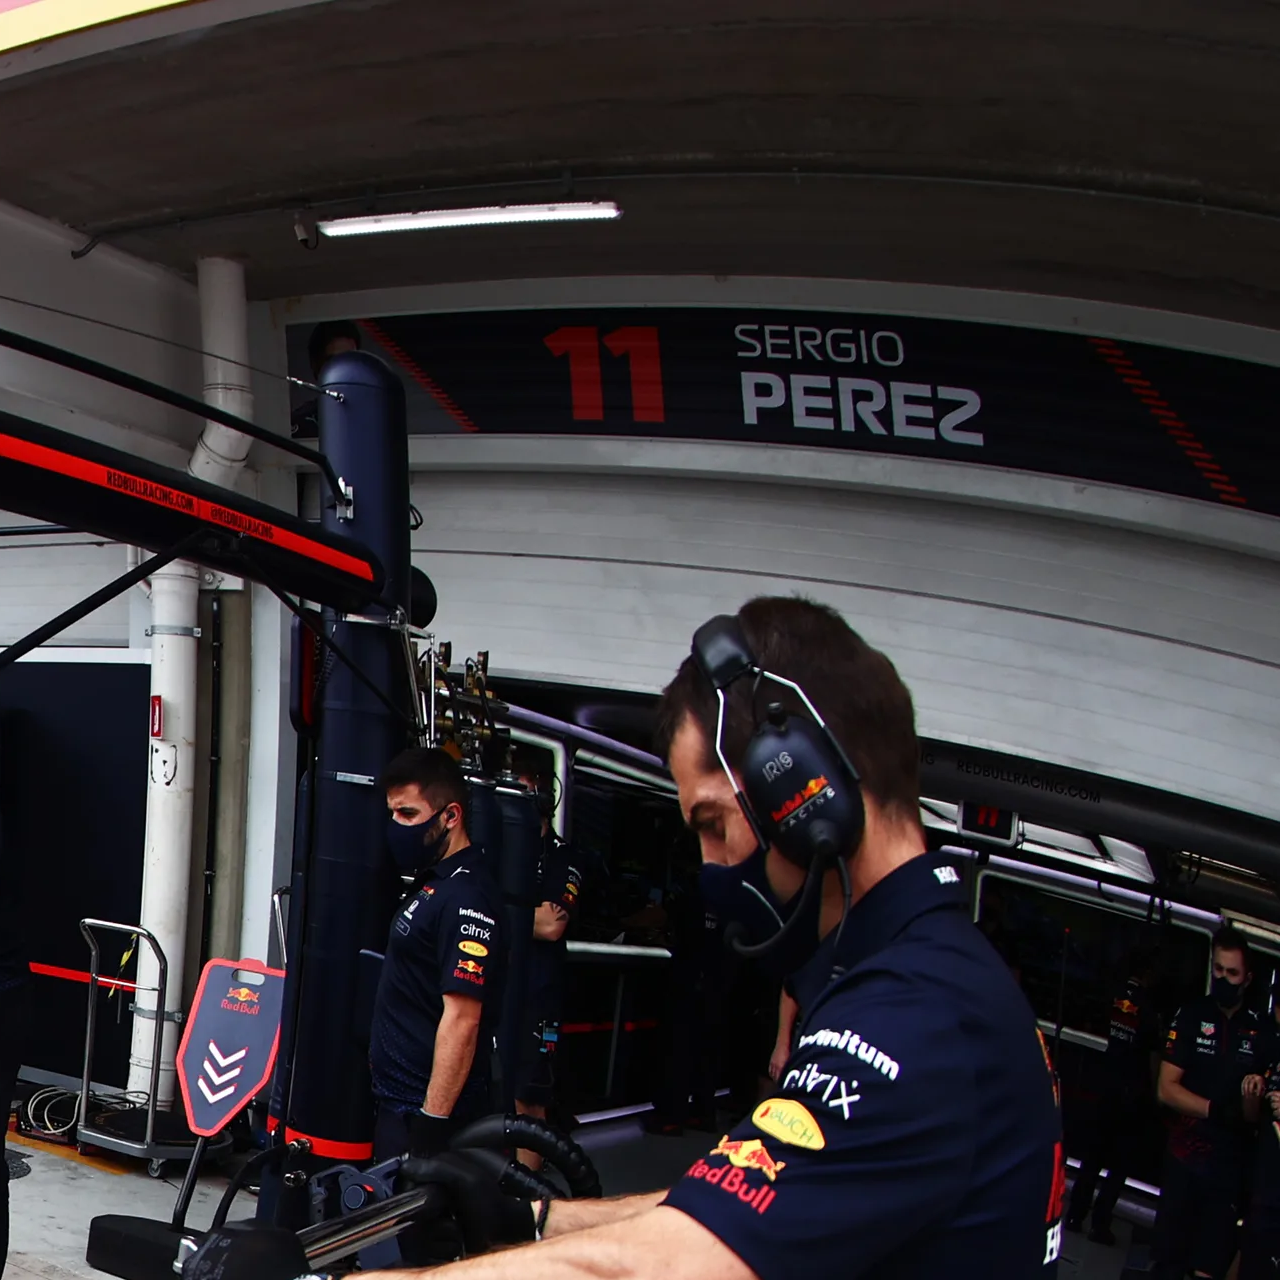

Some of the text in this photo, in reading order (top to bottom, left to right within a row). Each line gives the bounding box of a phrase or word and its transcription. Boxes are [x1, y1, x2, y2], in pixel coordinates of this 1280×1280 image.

[734, 324, 905, 367] SERGIO
[544, 326, 665, 423] 11
[740, 371, 984, 446] PEREZ
[106, 471, 195, 512] REDBULLRACING.COM
[956, 759, 1102, 804] REDBULLRACING.COM
[459, 907, 495, 926] infinitum
[461, 923, 491, 941] citrix
[221, 998, 260, 1016] Red Bull
[721, 1163, 777, 1214] Bull
